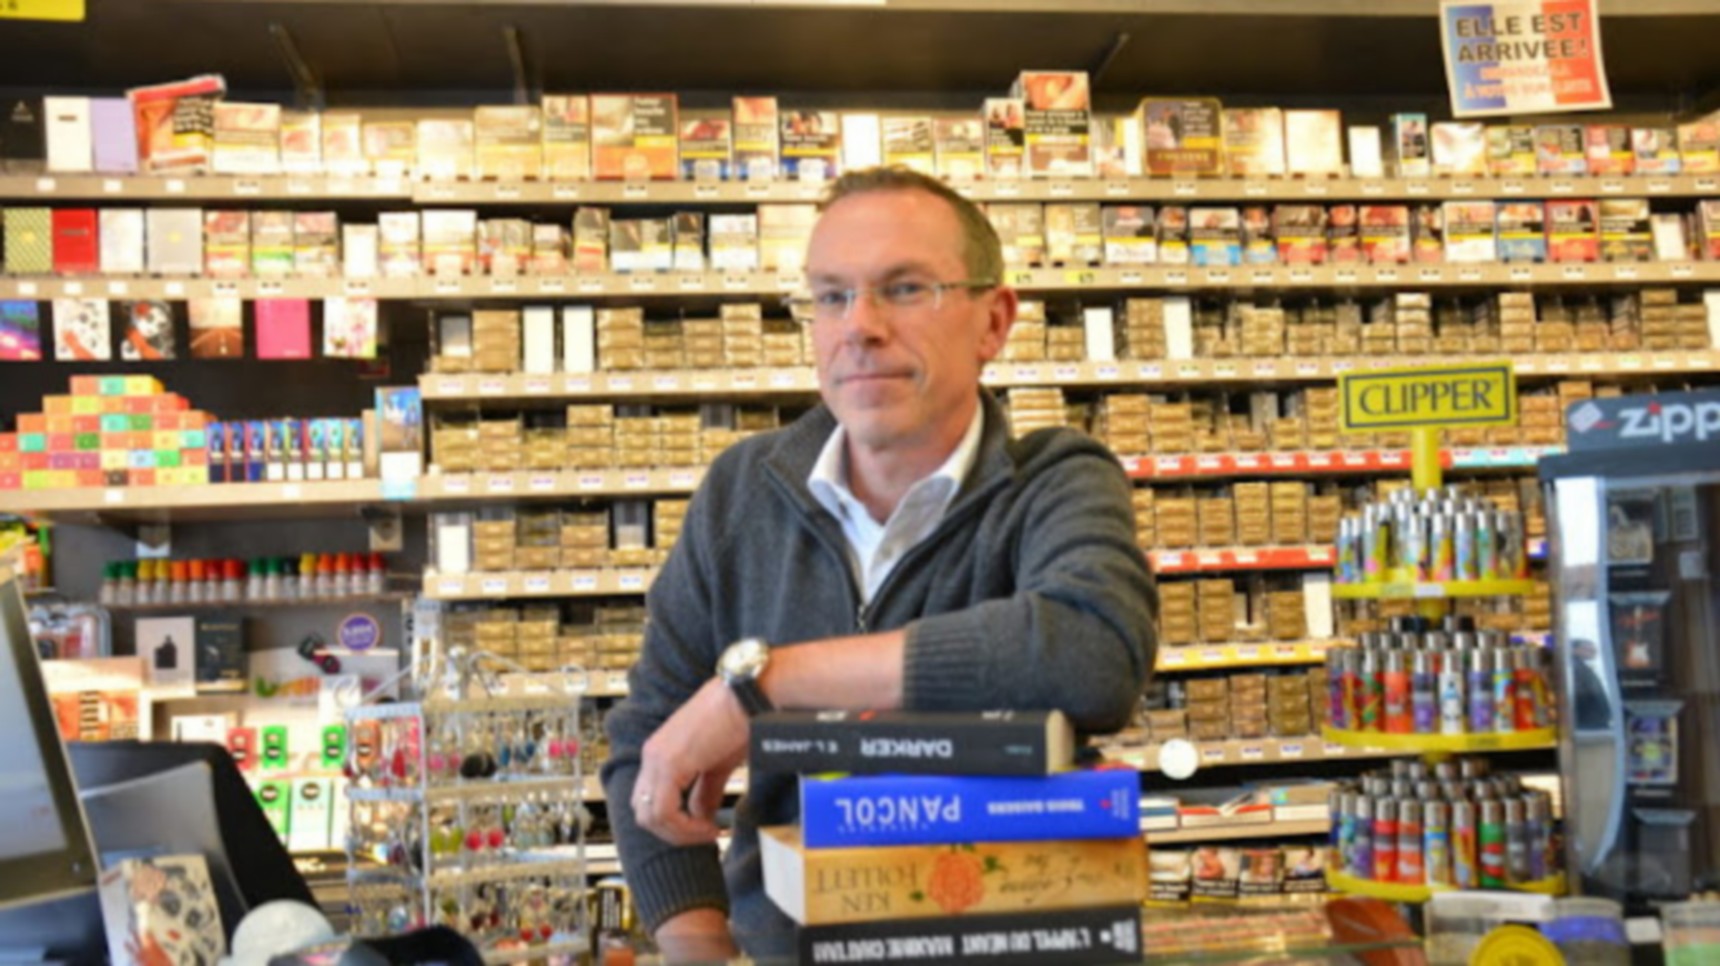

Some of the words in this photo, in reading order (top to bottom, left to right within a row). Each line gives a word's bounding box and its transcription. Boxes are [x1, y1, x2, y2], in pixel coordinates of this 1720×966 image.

[1456, 16, 1522, 37] ELLE
[1531, 13, 1582, 33] EST
[1359, 379, 1493, 415] CLIPPER
[762, 739, 813, 752] JAMES
[860, 738, 953, 757] DARKER
[835, 795, 961, 826] PANCOL
[818, 862, 917, 893] FOLLETT
[842, 889, 890, 914] KEN
